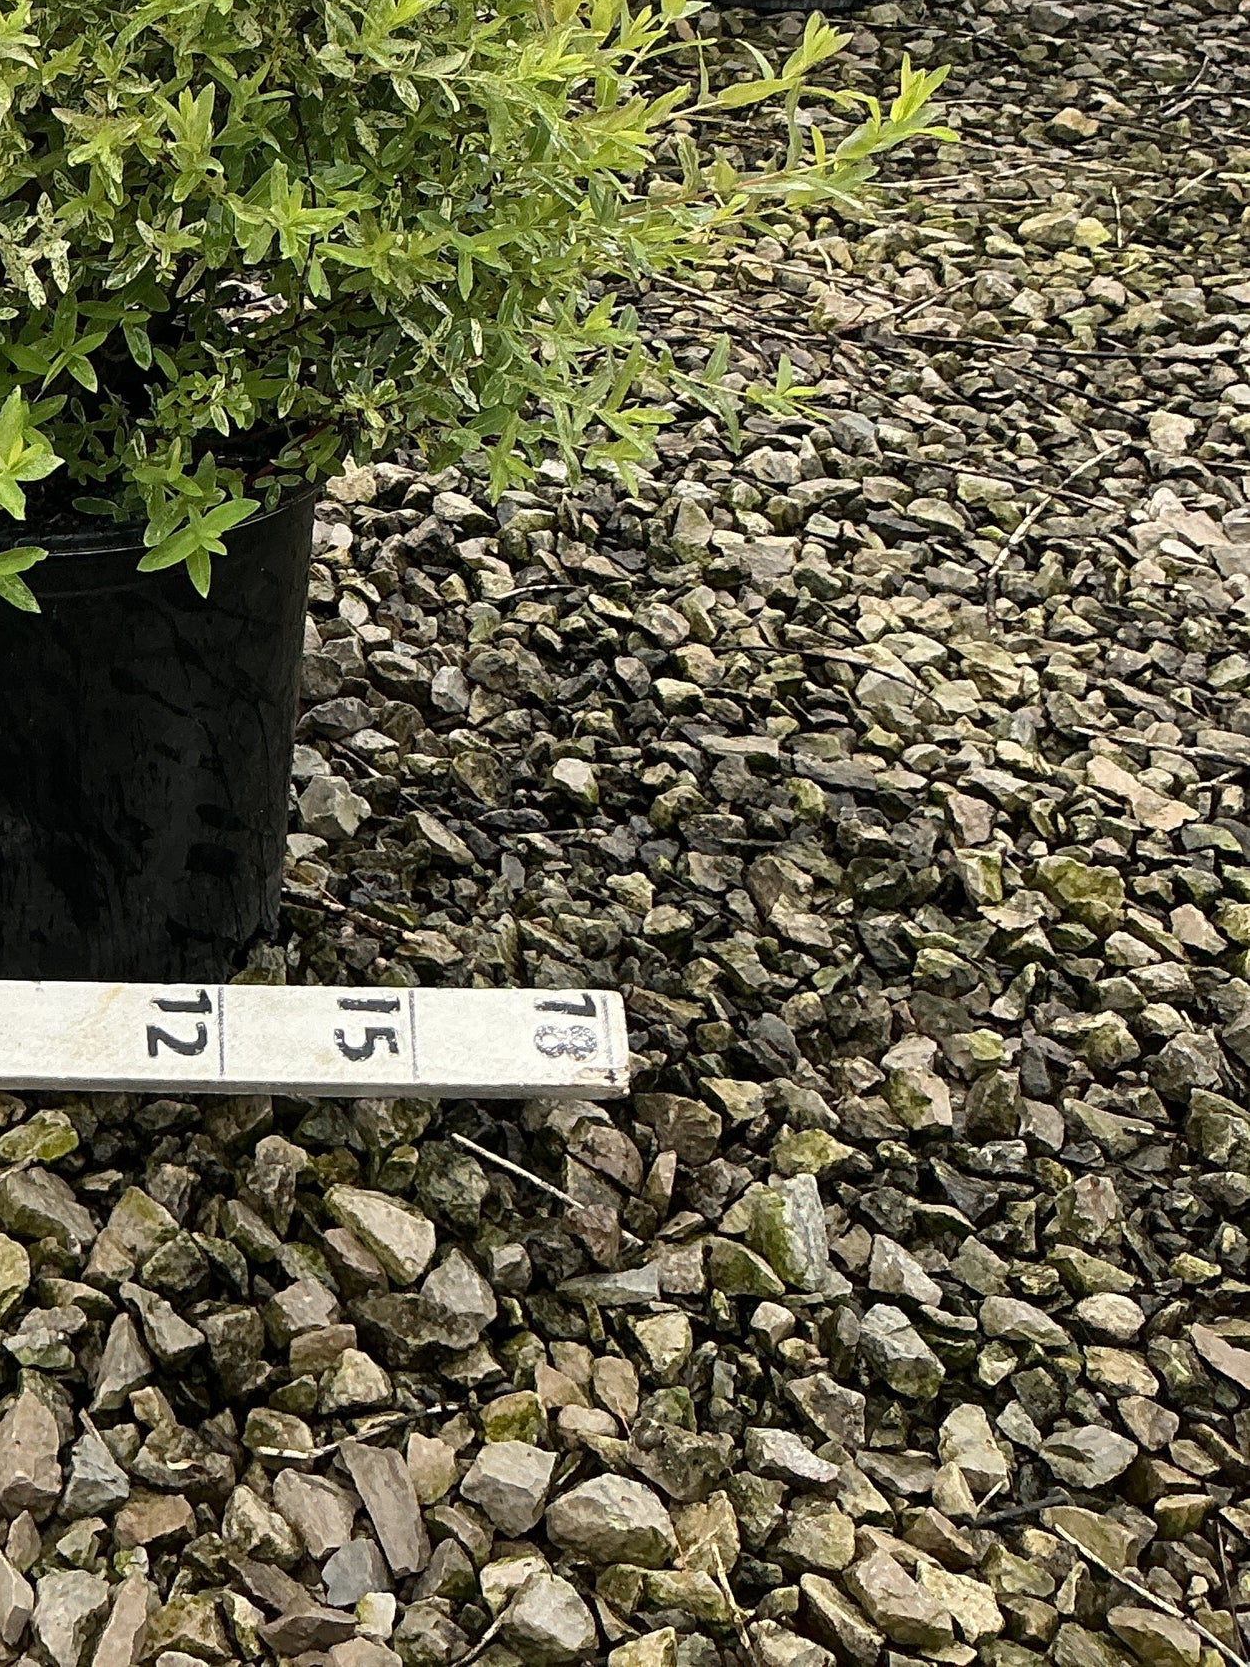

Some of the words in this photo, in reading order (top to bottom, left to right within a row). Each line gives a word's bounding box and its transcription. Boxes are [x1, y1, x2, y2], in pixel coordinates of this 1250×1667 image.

[146, 988, 213, 1058] 12
[334, 994, 401, 1062] 15
[533, 992, 598, 1062] 18
